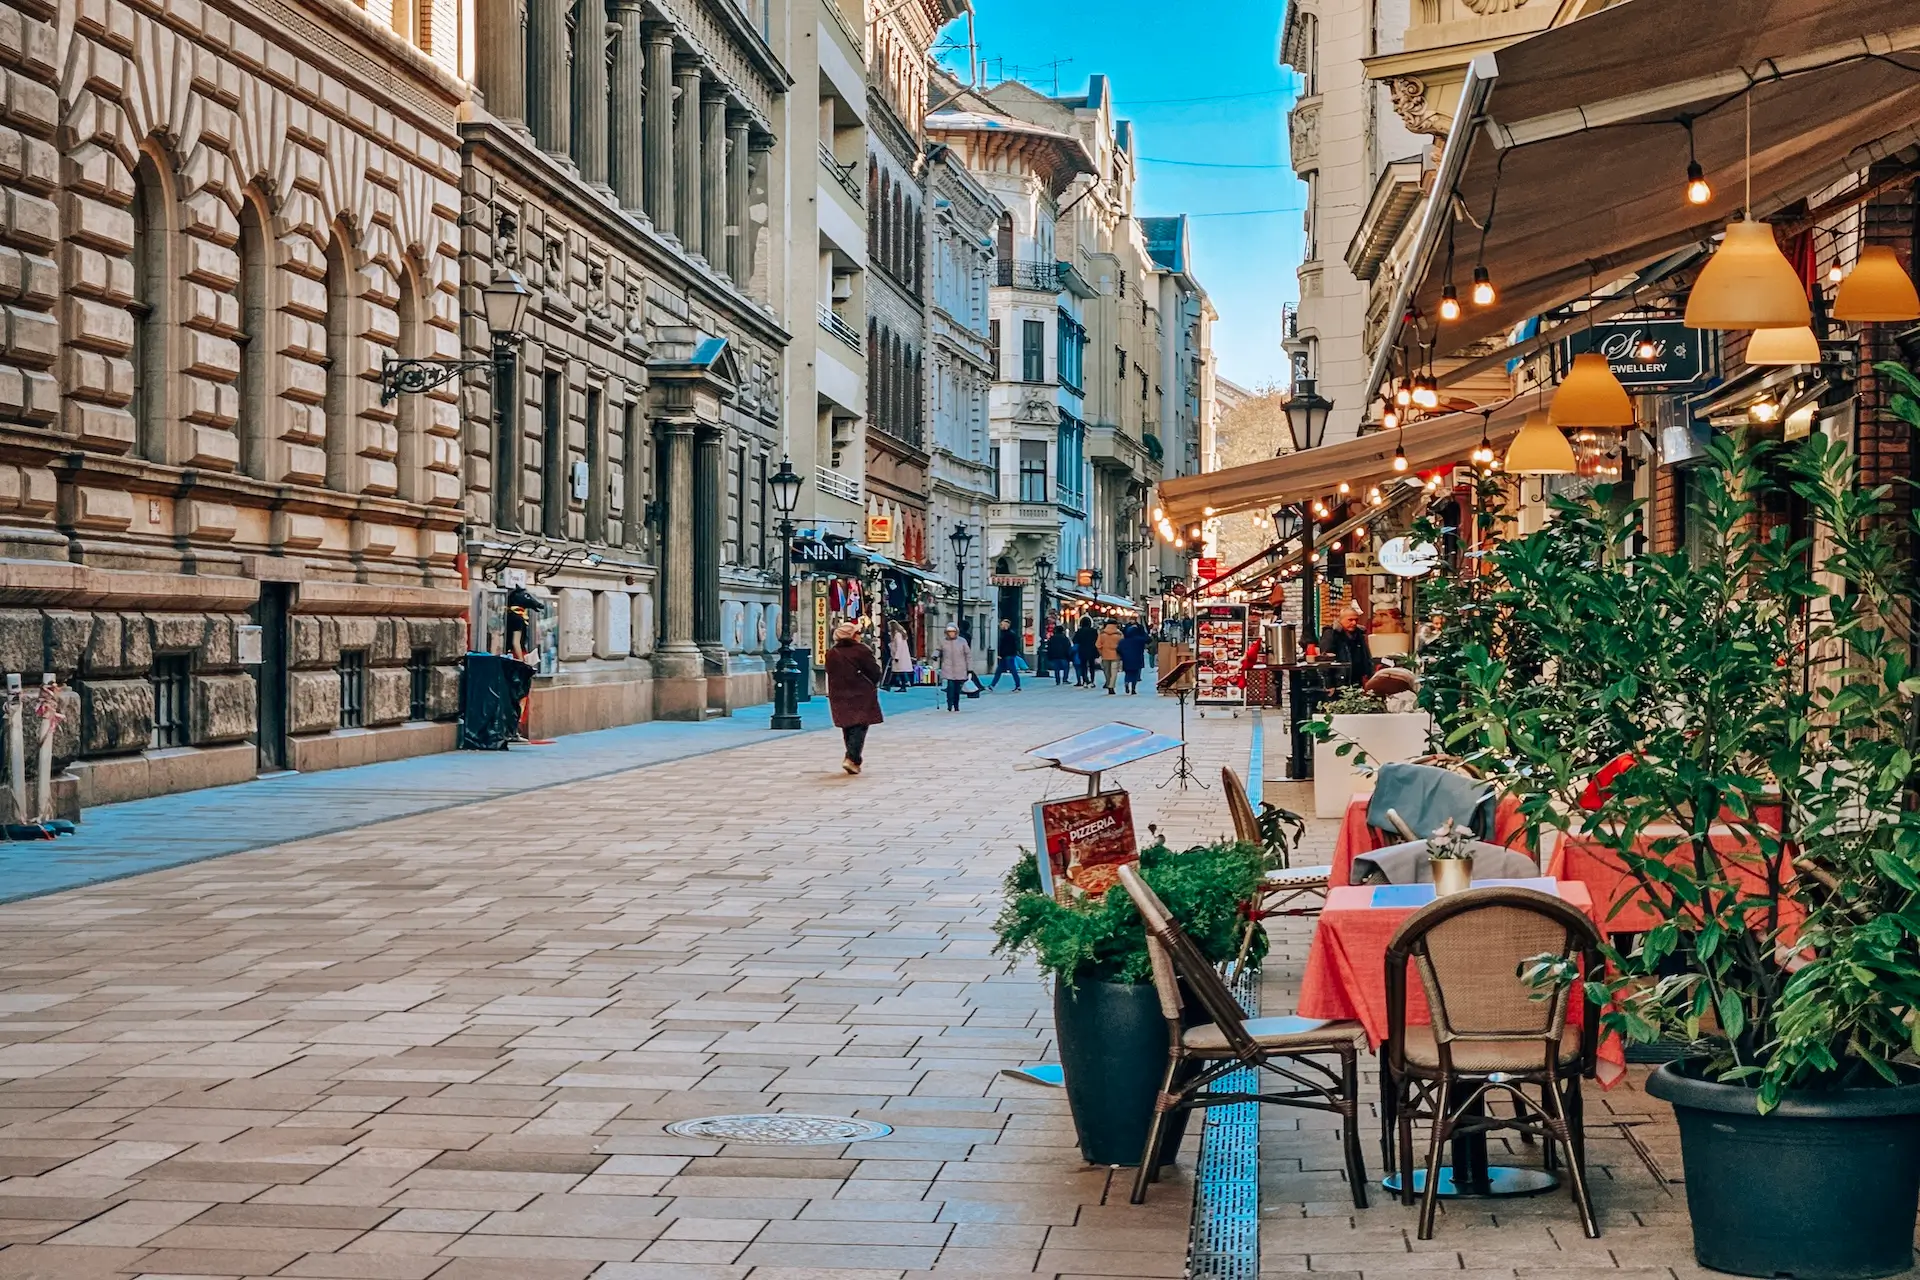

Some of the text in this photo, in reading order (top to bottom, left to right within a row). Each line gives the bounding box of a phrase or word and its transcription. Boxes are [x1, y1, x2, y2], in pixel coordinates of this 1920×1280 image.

[1610, 363, 1667, 373] EWELLERY
[803, 544, 844, 560] NINI
[1070, 815, 1116, 842] PIZZERIA
